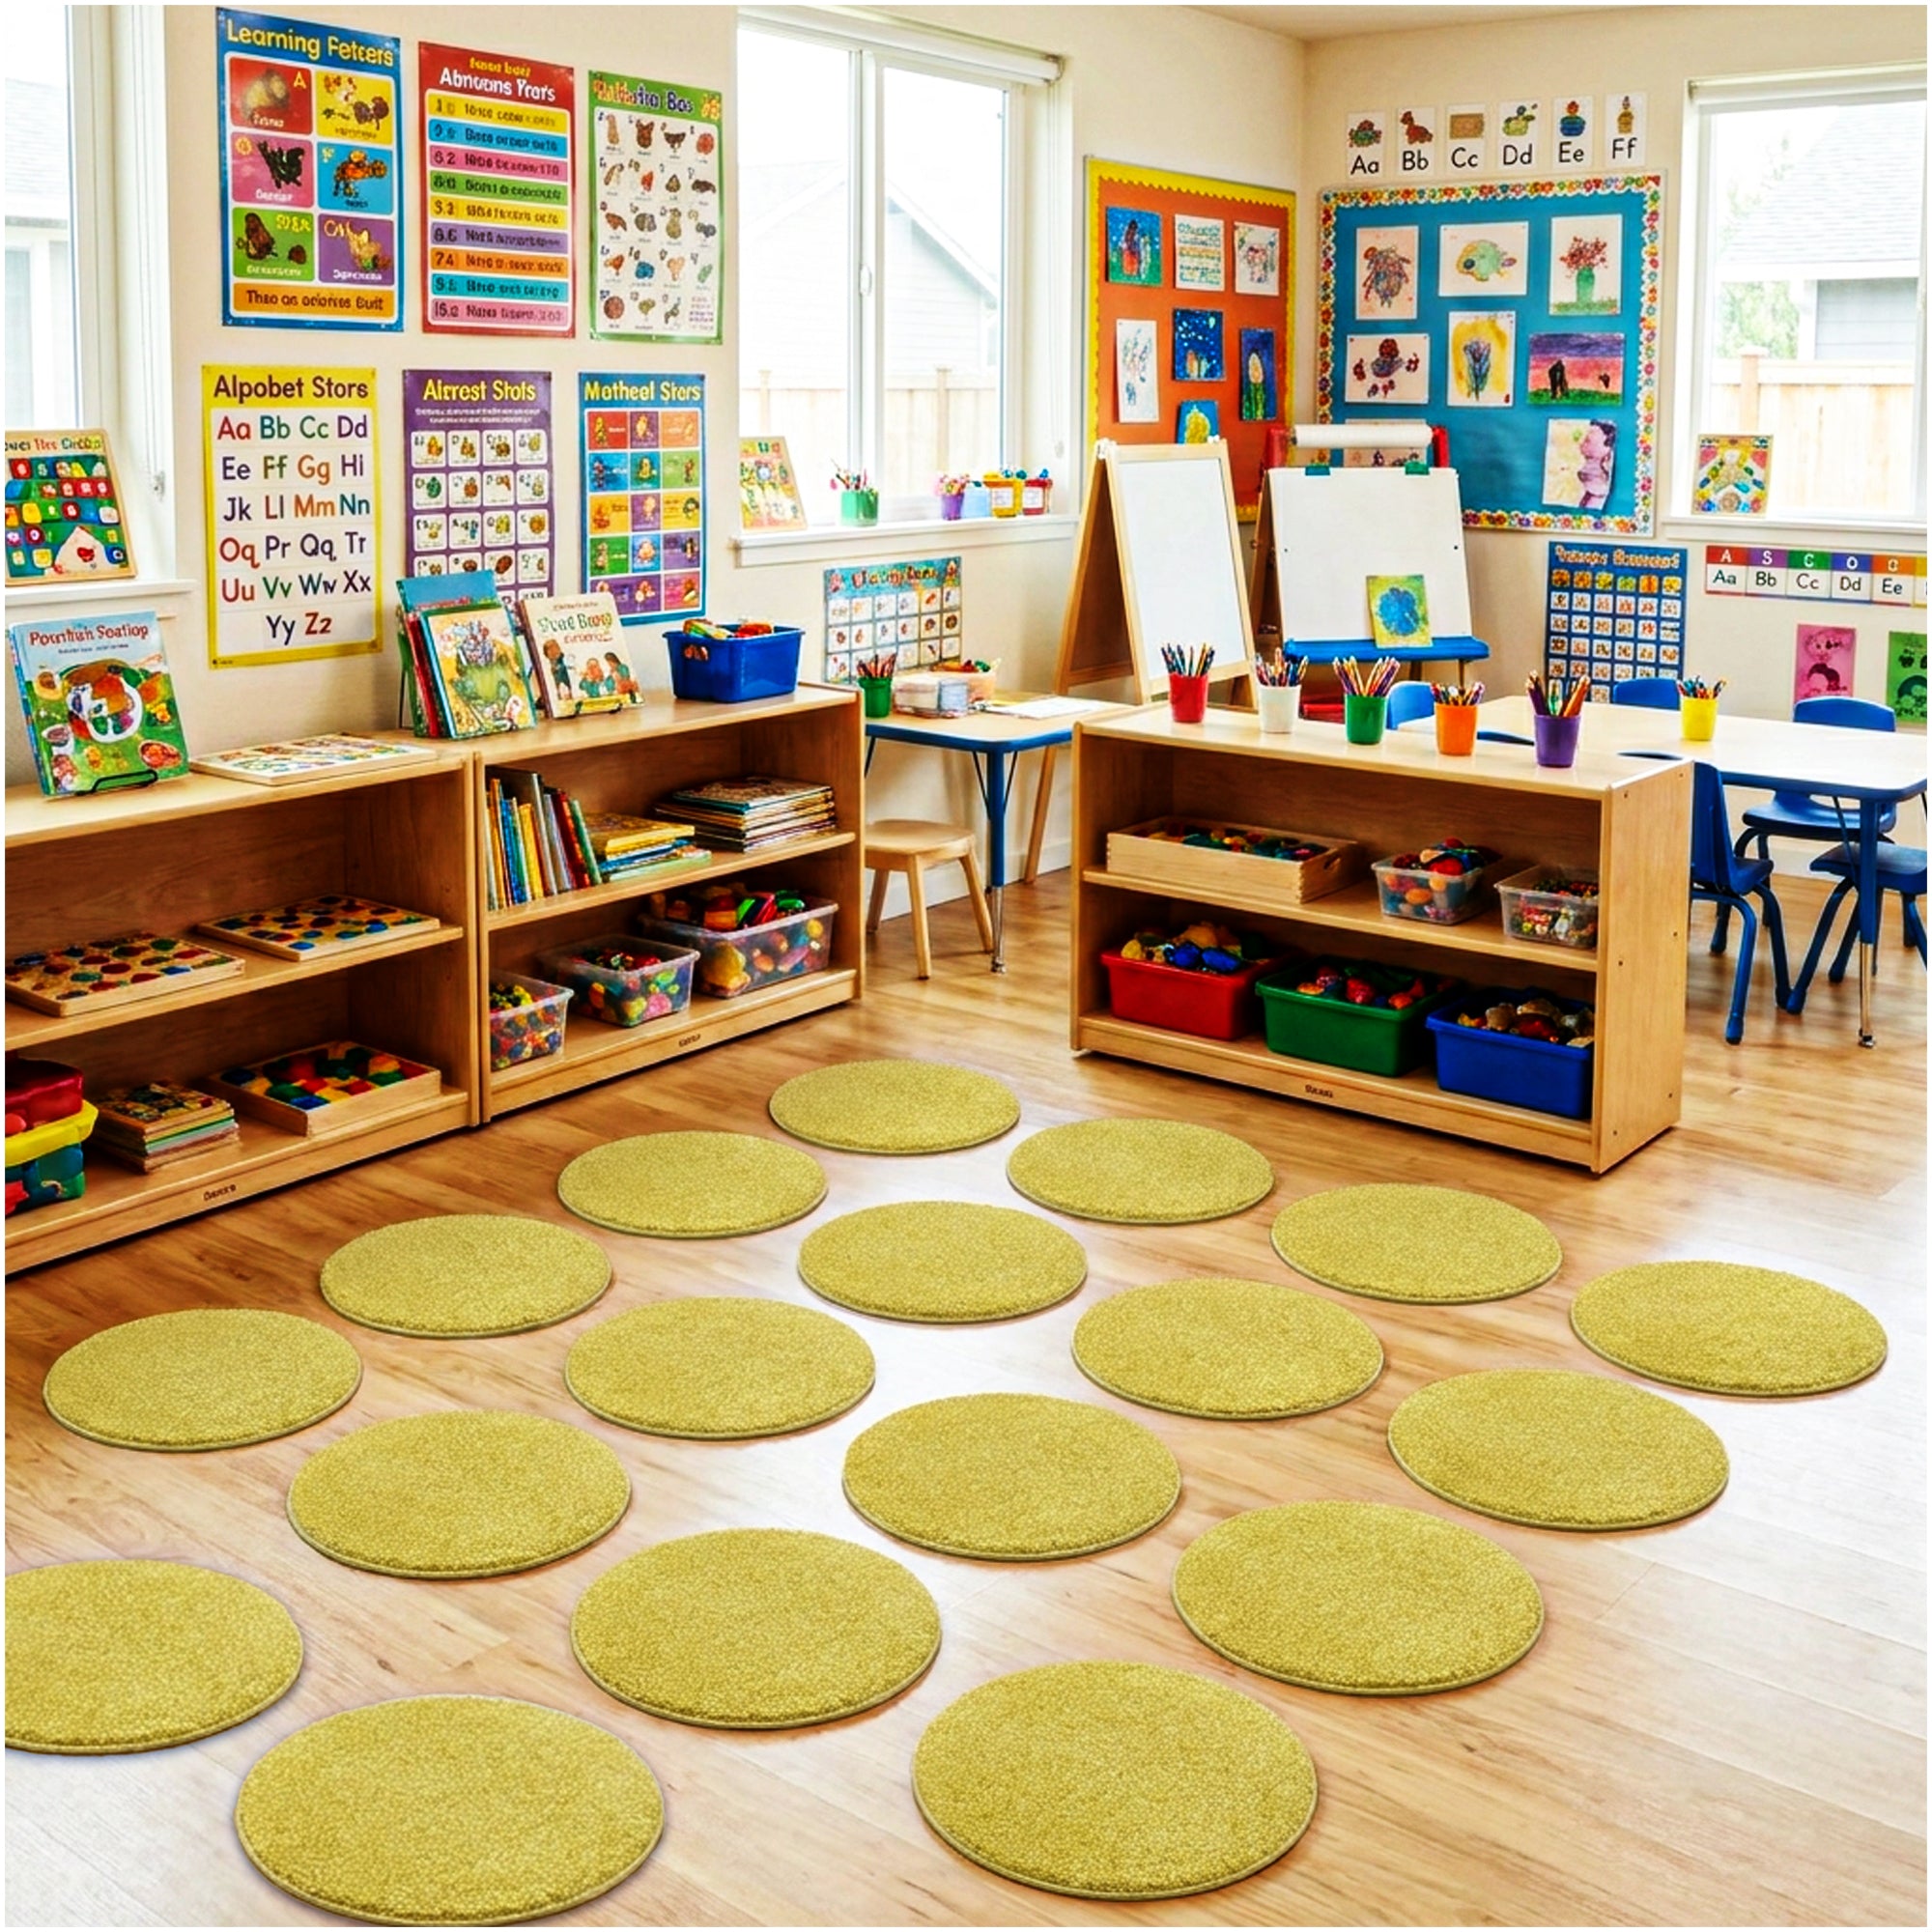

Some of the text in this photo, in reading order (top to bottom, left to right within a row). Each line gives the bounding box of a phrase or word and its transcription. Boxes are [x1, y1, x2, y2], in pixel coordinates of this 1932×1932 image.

[226, 18, 321, 61] Learning
[1451, 147, 1478, 168] Cc
[1503, 143, 1533, 165] Dd
[1558, 141, 1584, 163] Ee
[1612, 137, 1637, 159] Ff
[1350, 155, 1379, 175] Aa
[1403, 150, 1429, 171] Bb
[217, 414, 368, 440] Aa Bb Cc Dd
[222, 454, 363, 485] Ee Ff Gg Hi
[223, 494, 370, 522] Jk Ll Mm Nn
[219, 531, 367, 570] Oq Pr Qq Tr
[1720, 549, 1733, 563] A
[1761, 550, 1774, 565] S
[222, 578, 255, 603] Uu
[262, 576, 293, 600] Vv
[343, 570, 371, 593] Xx
[1713, 570, 1902, 595] Aa Bb Cc Dd Ee
[266, 615, 296, 646] Yy
